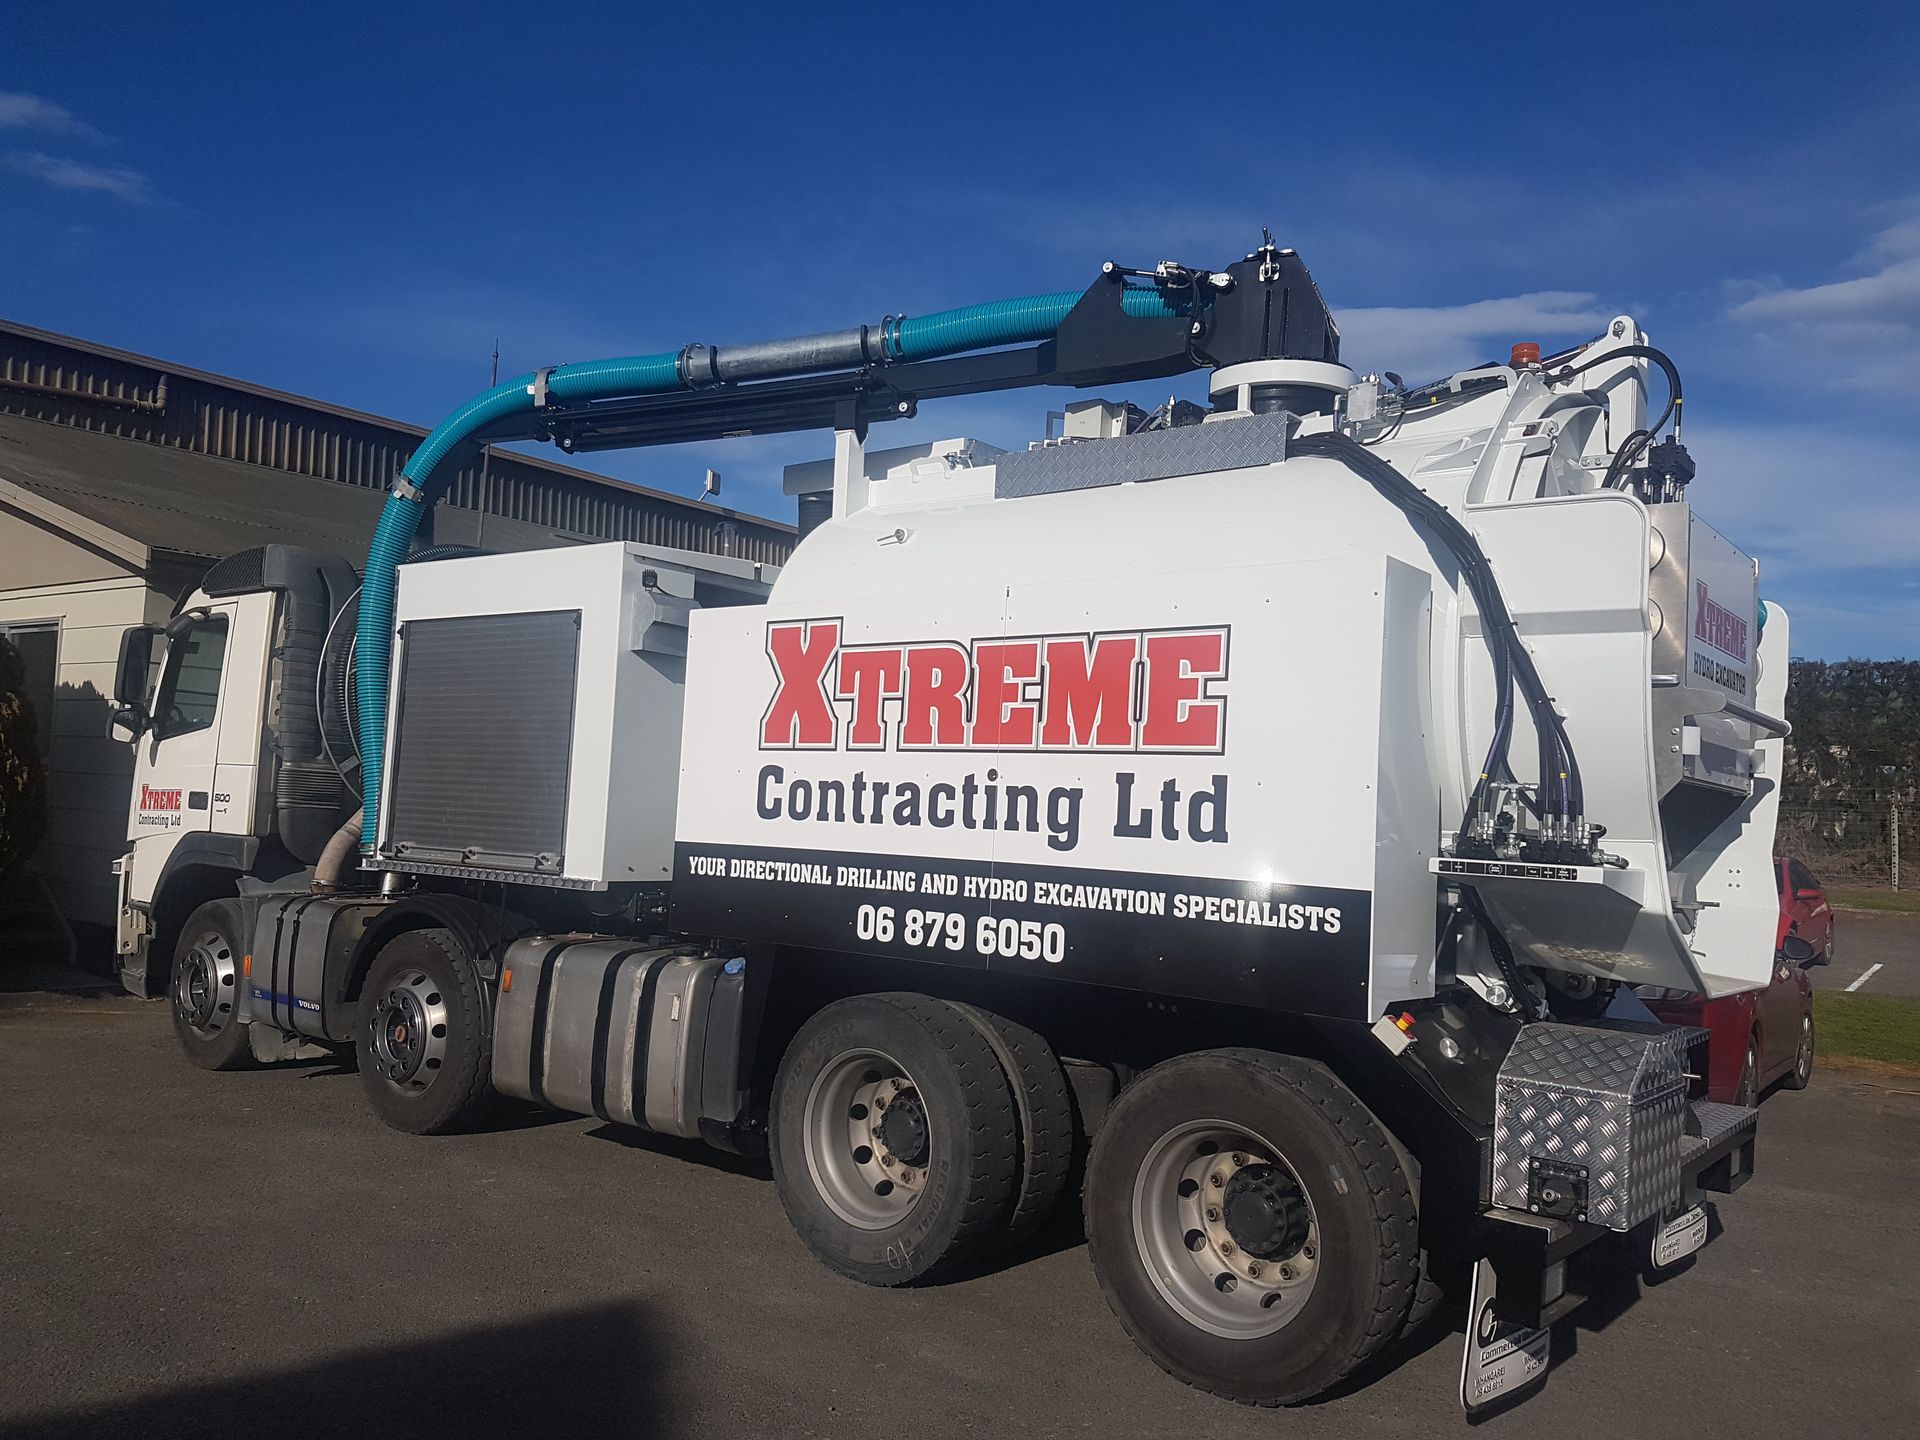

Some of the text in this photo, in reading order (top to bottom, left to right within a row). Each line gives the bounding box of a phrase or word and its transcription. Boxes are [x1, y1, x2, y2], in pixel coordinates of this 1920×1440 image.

[1694, 578, 1747, 664] XTREME
[758, 616, 1232, 755] XTREME
[1693, 651, 1746, 696] HYDRO EXCAVATOR
[138, 813, 182, 829] Contracting Ltd
[140, 783, 183, 811] XTREME
[214, 793, 231, 803] 500
[757, 764, 1230, 852] Contracting Ltd
[689, 856, 1341, 934] YOUR DIRECTIONAL DRILLING AND HYDRO EXCAVATION SPECIALISTS
[856, 904, 1064, 963] 06 879 6050
[298, 1000, 320, 1011] VOLVO
